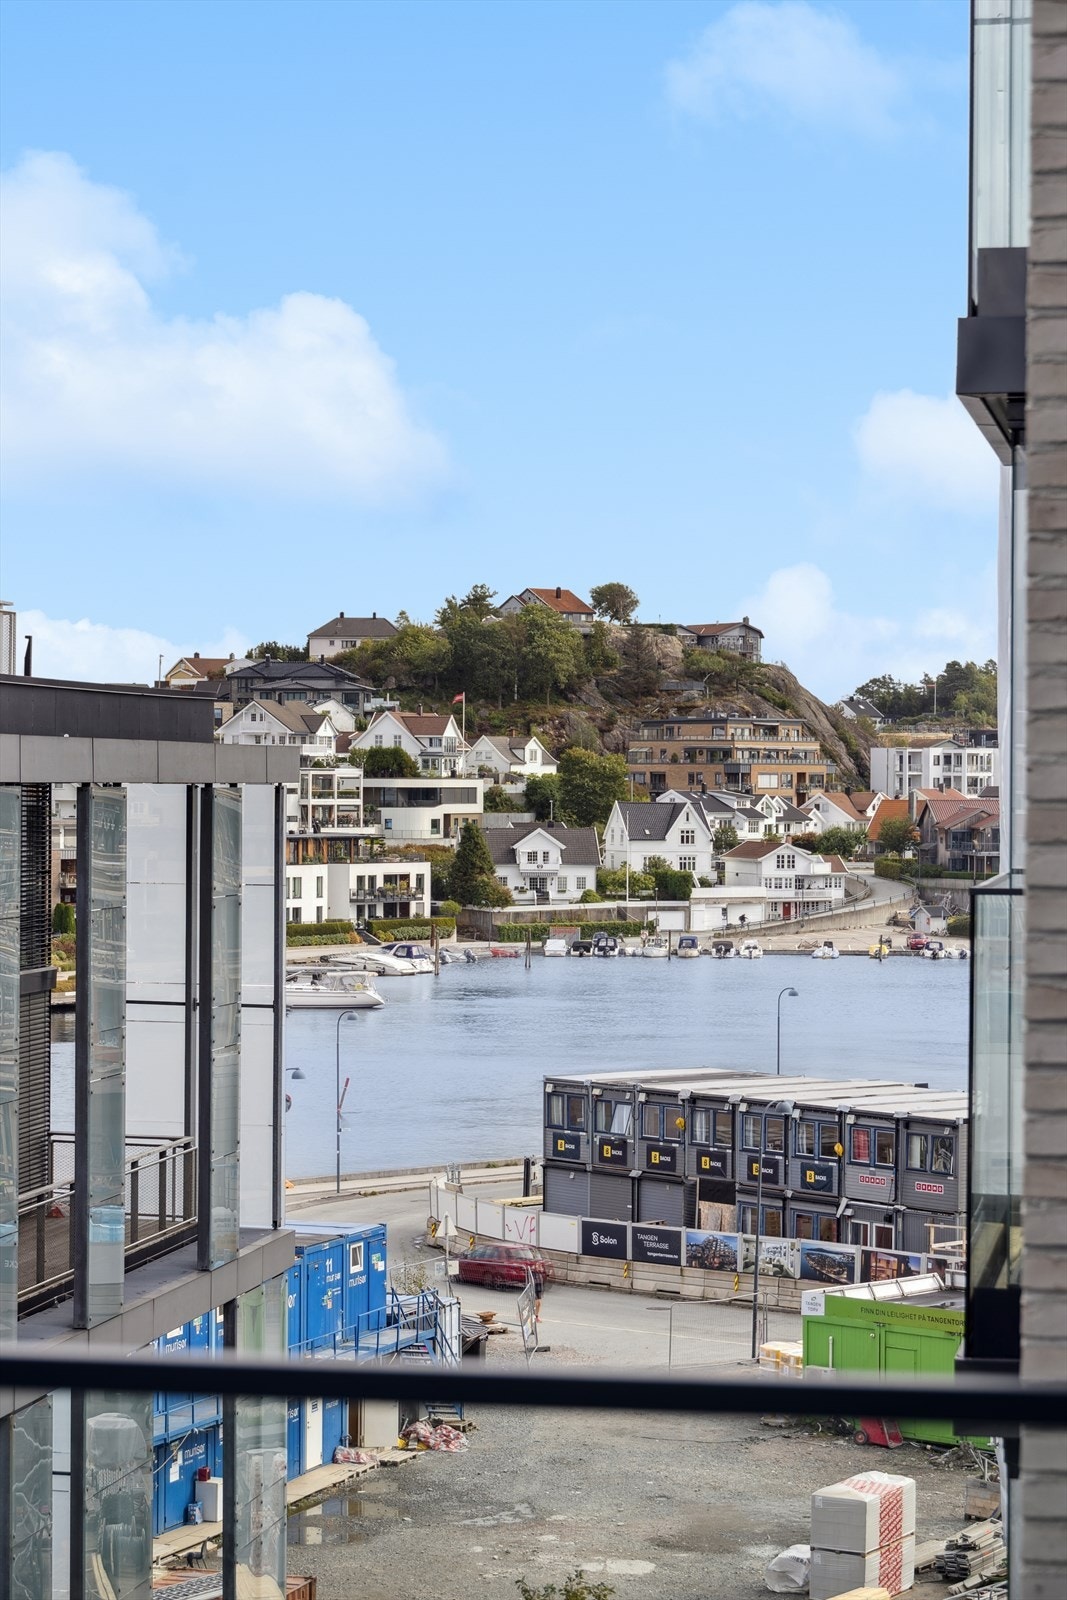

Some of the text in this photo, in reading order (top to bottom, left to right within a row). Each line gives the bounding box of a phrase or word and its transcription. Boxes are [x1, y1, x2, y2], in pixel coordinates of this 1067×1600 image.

[762, 1167, 773, 1175] BACKE
[600, 1235, 617, 1245] Solon
[637, 1233, 658, 1241] TANGEN
[643, 1241, 669, 1249] TERRASSE
[325, 1258, 333, 1273] 11
[887, 1311, 917, 1320] LEILIGHET
[927, 1316, 964, 1326] TANGENTOR
